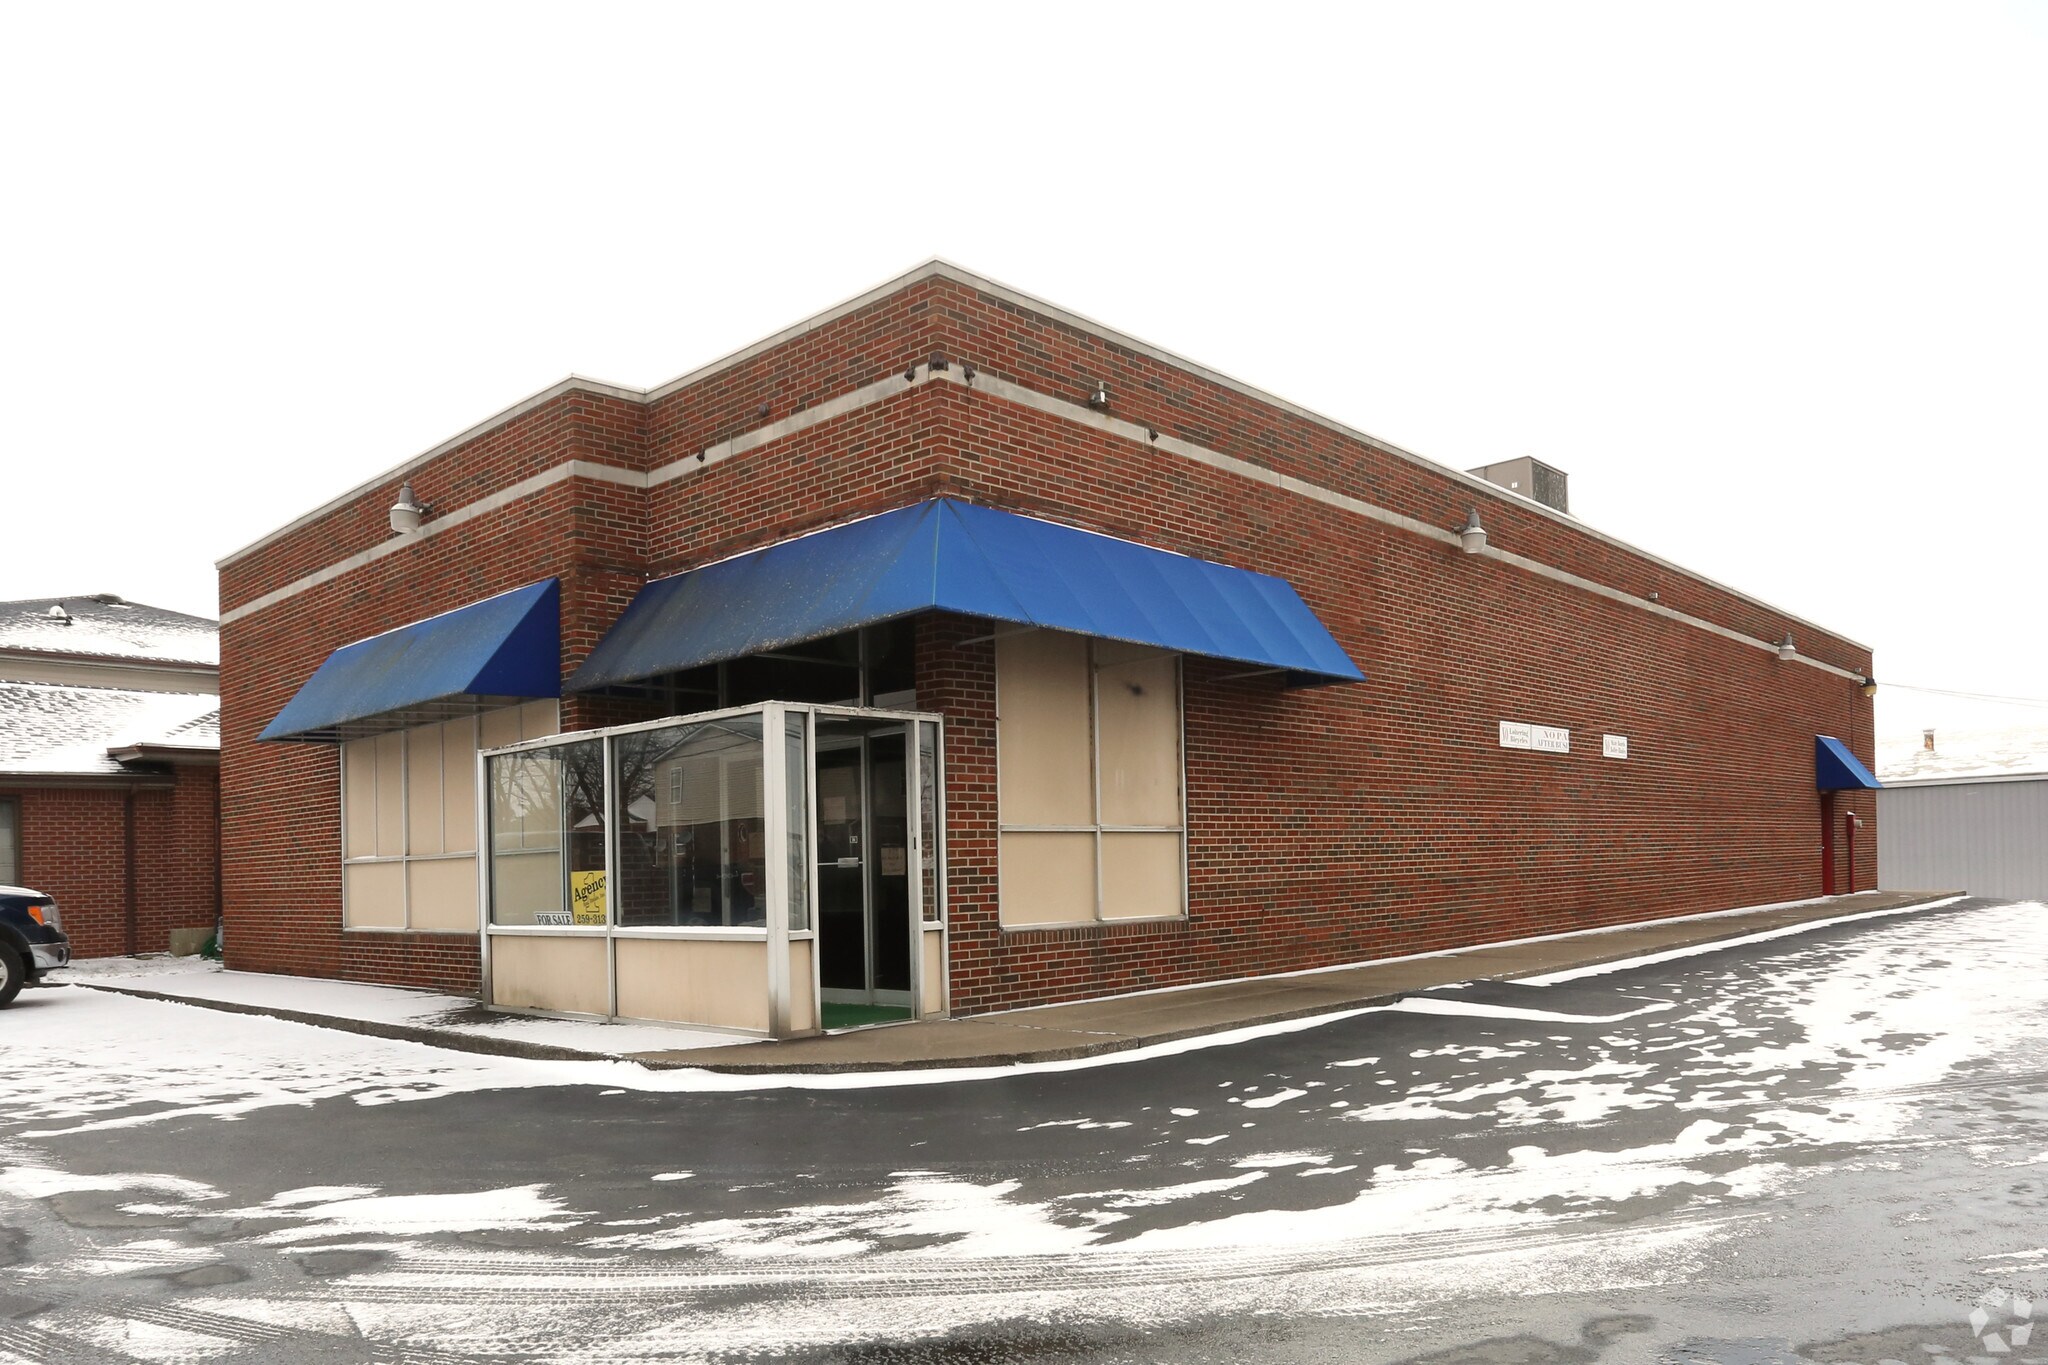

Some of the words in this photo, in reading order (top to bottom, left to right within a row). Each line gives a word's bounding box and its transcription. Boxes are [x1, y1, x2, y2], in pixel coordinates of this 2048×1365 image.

[1544, 731, 1555, 739] NO
[1538, 739, 1554, 748] AFTER
[537, 915, 551, 925] FOR
[552, 915, 571, 925] SALE
